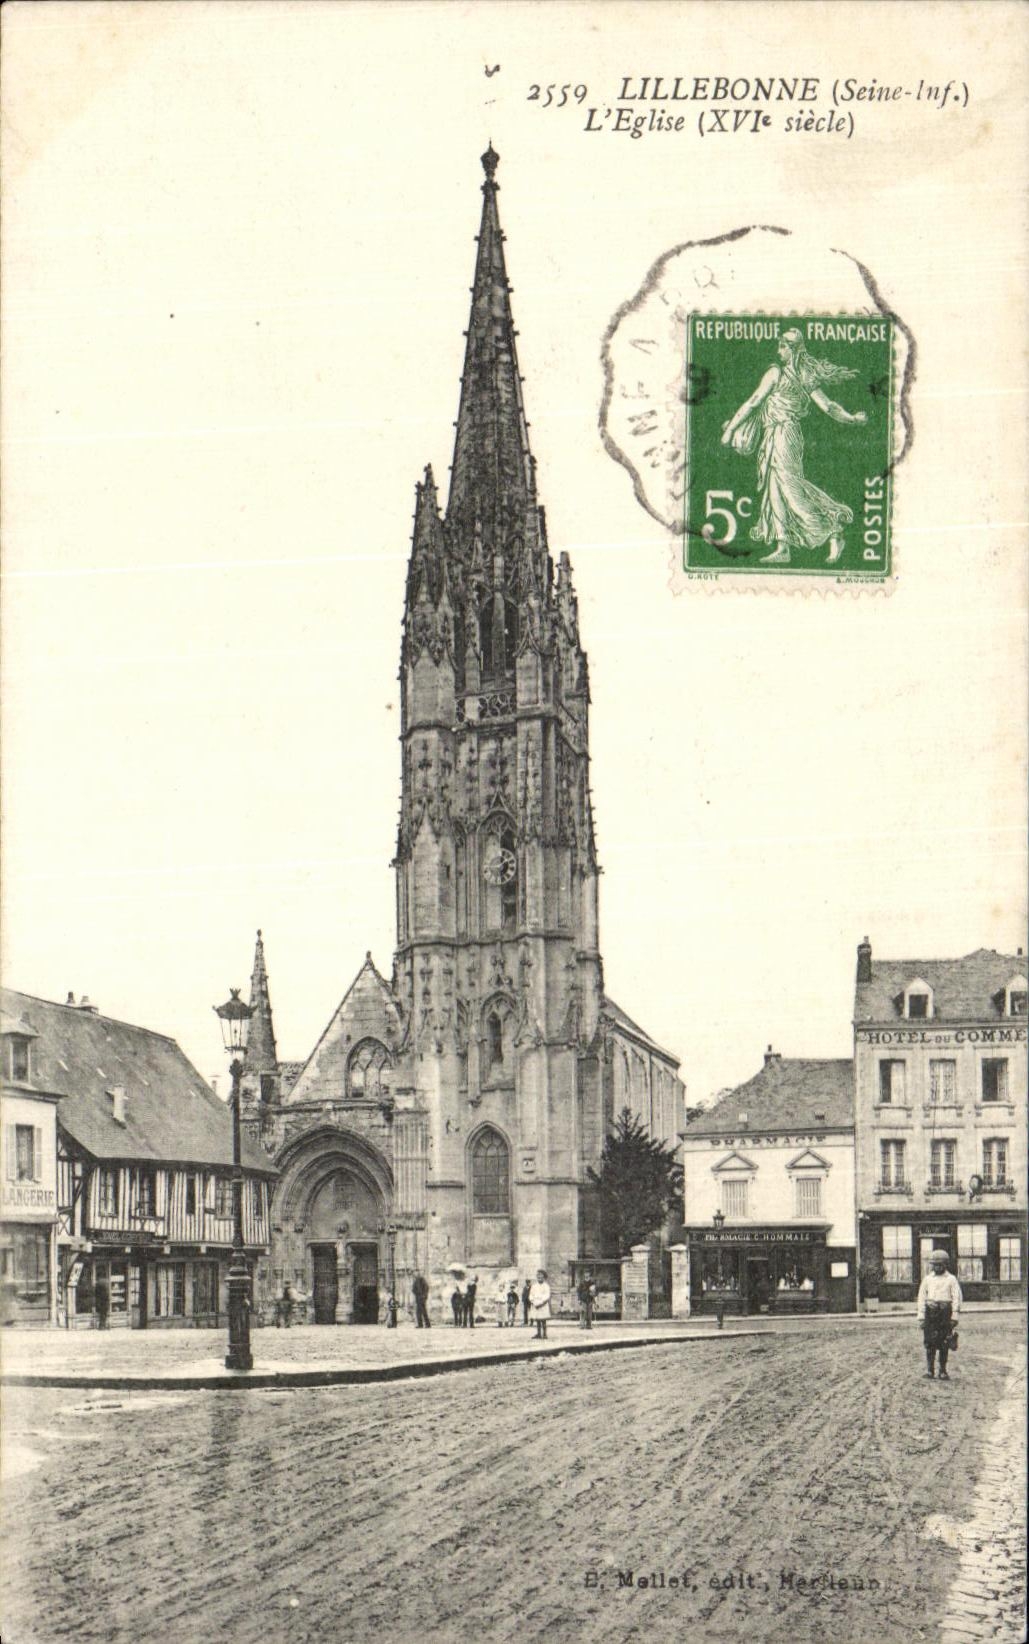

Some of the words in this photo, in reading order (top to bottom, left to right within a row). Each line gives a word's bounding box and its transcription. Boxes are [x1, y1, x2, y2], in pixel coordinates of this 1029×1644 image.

[807, 322, 887, 344] FRANÇAISE
[863, 476, 884, 561] POSTES
[868, 1031, 932, 1045] HOTEL
